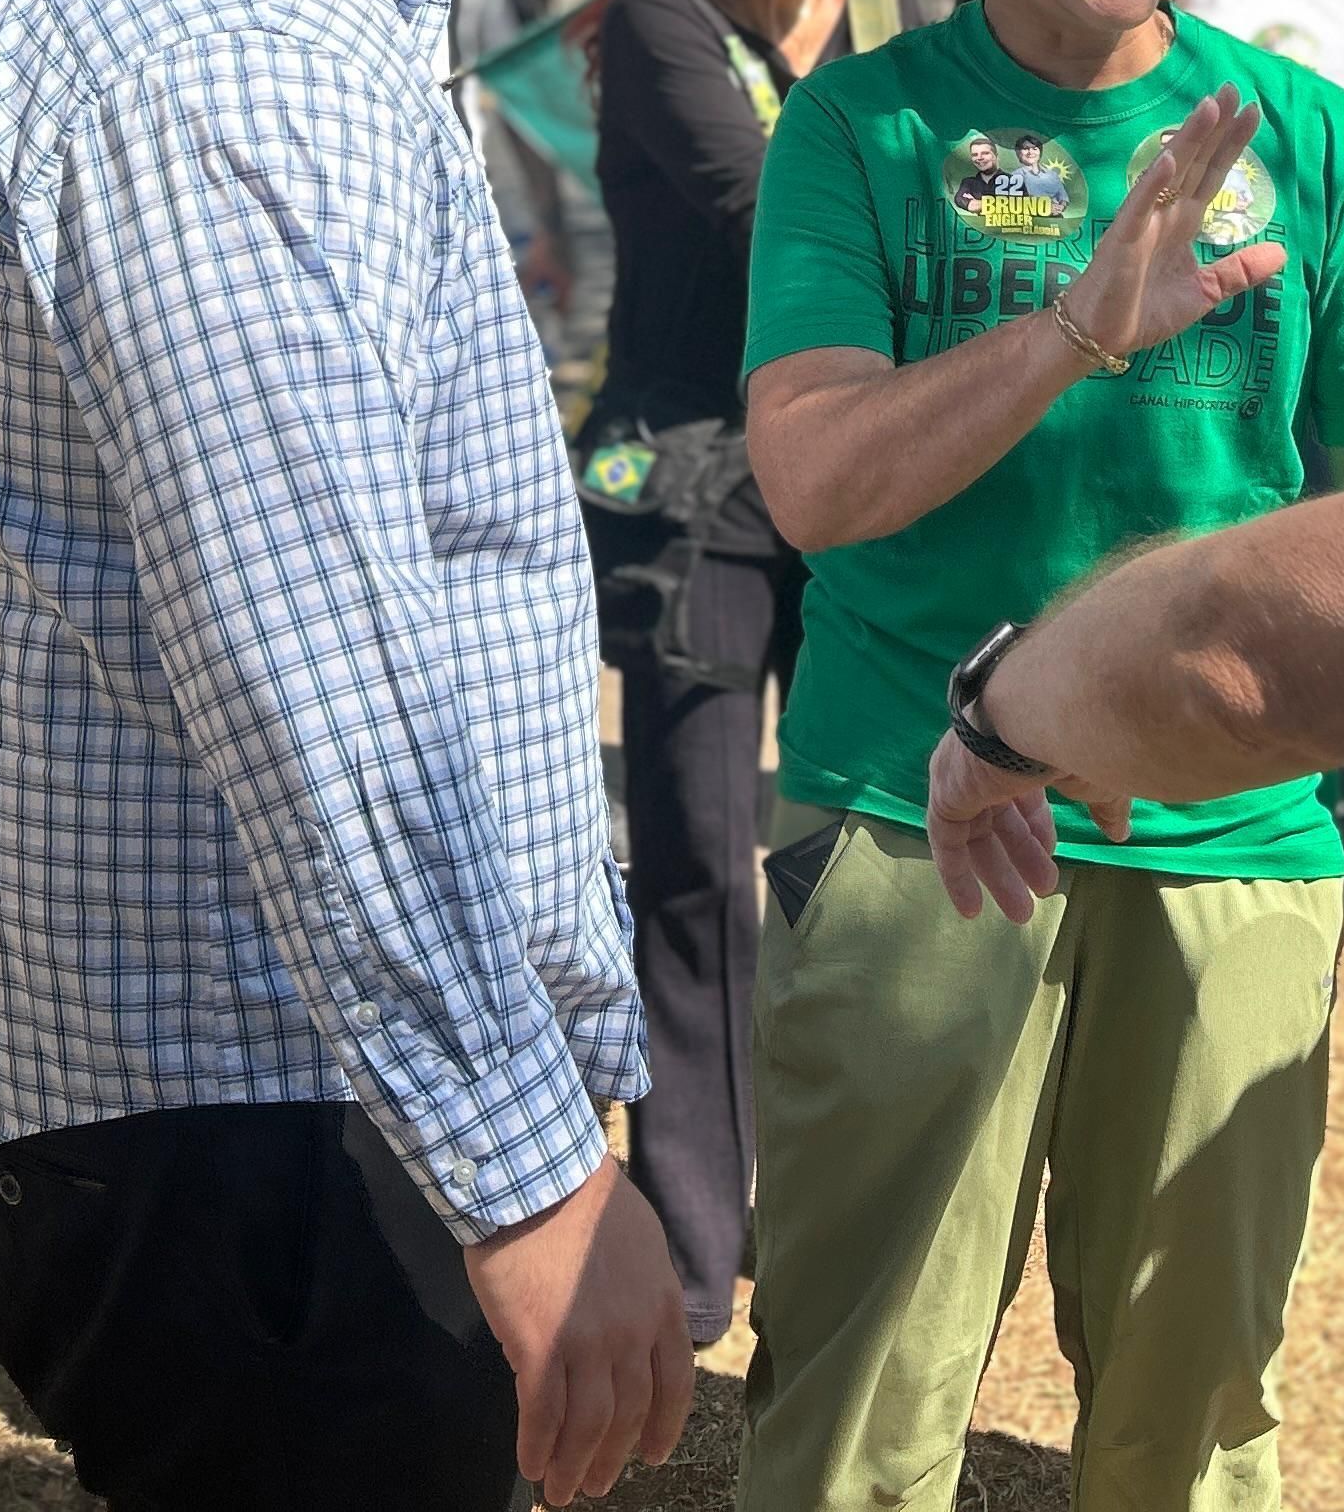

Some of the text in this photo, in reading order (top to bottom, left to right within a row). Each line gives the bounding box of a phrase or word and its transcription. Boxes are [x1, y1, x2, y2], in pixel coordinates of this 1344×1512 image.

[994, 174, 1024, 196] 22
[981, 195, 1052, 217] BRUNO
[985, 213, 1033, 227] ENGLER
[1130, 394, 1169, 408] CANAL
